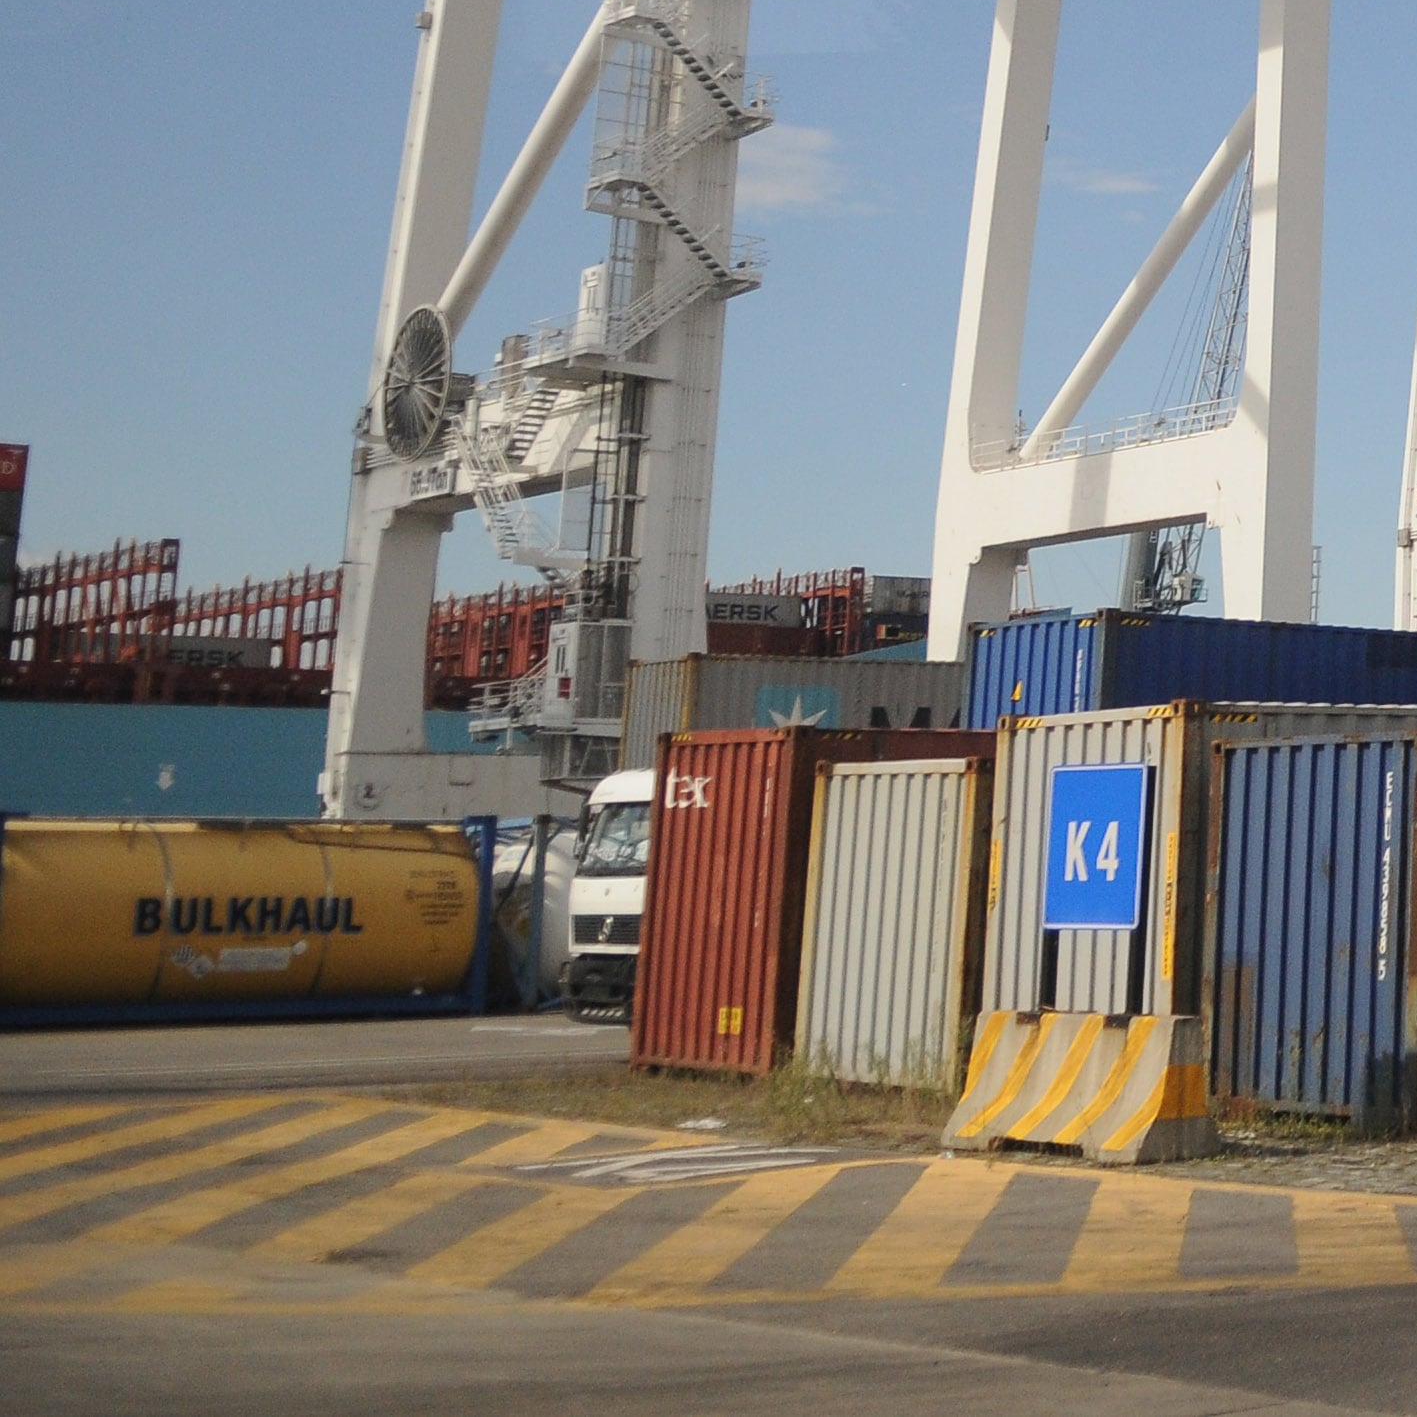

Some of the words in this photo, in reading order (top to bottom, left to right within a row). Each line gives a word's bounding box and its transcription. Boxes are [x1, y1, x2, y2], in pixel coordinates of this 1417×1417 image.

[1383, 772, 1393, 841] ECMU
[133, 896, 363, 935] BULKHAUL
[1377, 960, 1386, 981] 5
